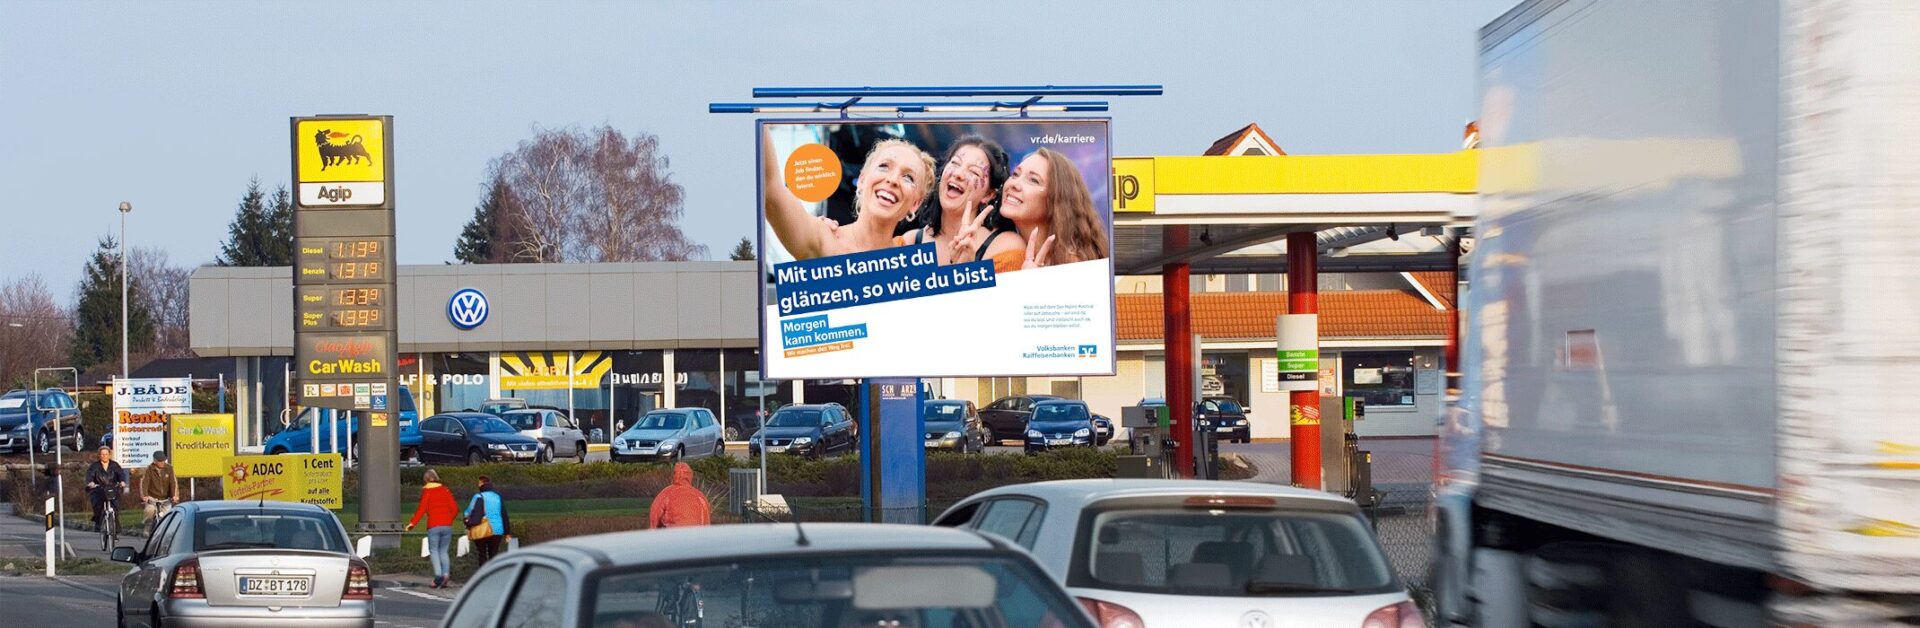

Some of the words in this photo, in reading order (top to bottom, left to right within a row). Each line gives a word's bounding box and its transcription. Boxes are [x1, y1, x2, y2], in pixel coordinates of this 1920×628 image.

[1030, 134, 1096, 144] vr.de/karriere
[317, 185, 352, 202] Agip
[302, 247, 323, 255] Diesel
[302, 267, 325, 275] Benzin
[777, 265, 808, 285] Mit
[811, 264, 843, 280] uns
[846, 253, 908, 275] kannst
[911, 249, 935, 266] du
[780, 288, 859, 313] glänzen,
[862, 284, 884, 299] so
[887, 275, 921, 295] wie
[925, 272, 949, 290] du
[953, 267, 994, 286] bist.
[303, 294, 323, 302] Super
[303, 311, 323, 319] Super
[783, 319, 827, 333] Morgen
[785, 335, 813, 346] kann
[814, 327, 865, 343] kommen.
[1036, 344, 1076, 352] Volksbanken
[426, 374, 437, 385] &
[442, 374, 484, 386] POLO
[177, 426, 193, 435] Car
[175, 441, 230, 450] Kreditkarten
[252, 462, 283, 476] ADAC
[303, 459, 308, 469] 1
[311, 458, 334, 469] Cent
[287, 579, 307, 591] 178
